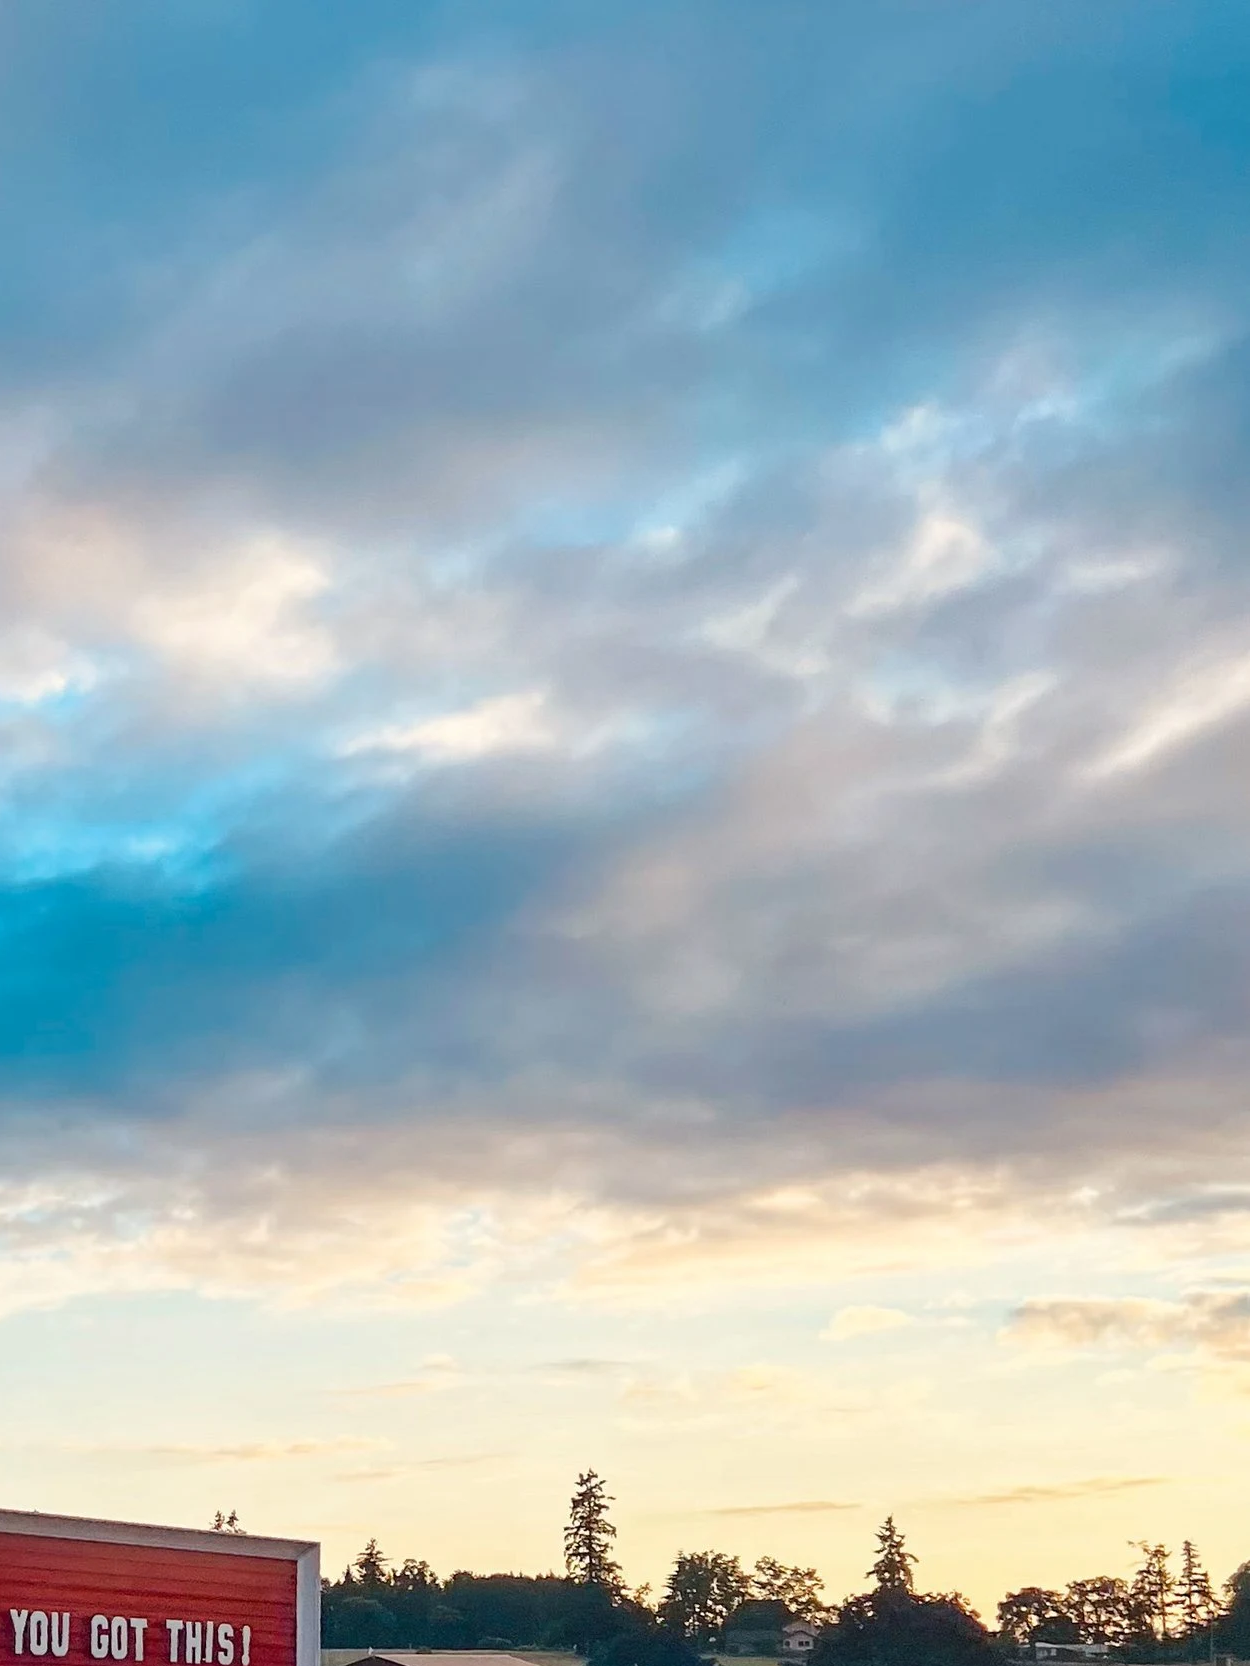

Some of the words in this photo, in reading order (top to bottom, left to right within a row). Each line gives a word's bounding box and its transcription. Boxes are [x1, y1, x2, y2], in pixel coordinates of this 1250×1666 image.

[10, 1608, 70, 1657] YOU
[90, 1614, 148, 1661] GOT
[166, 1618, 251, 1666] THIS!
